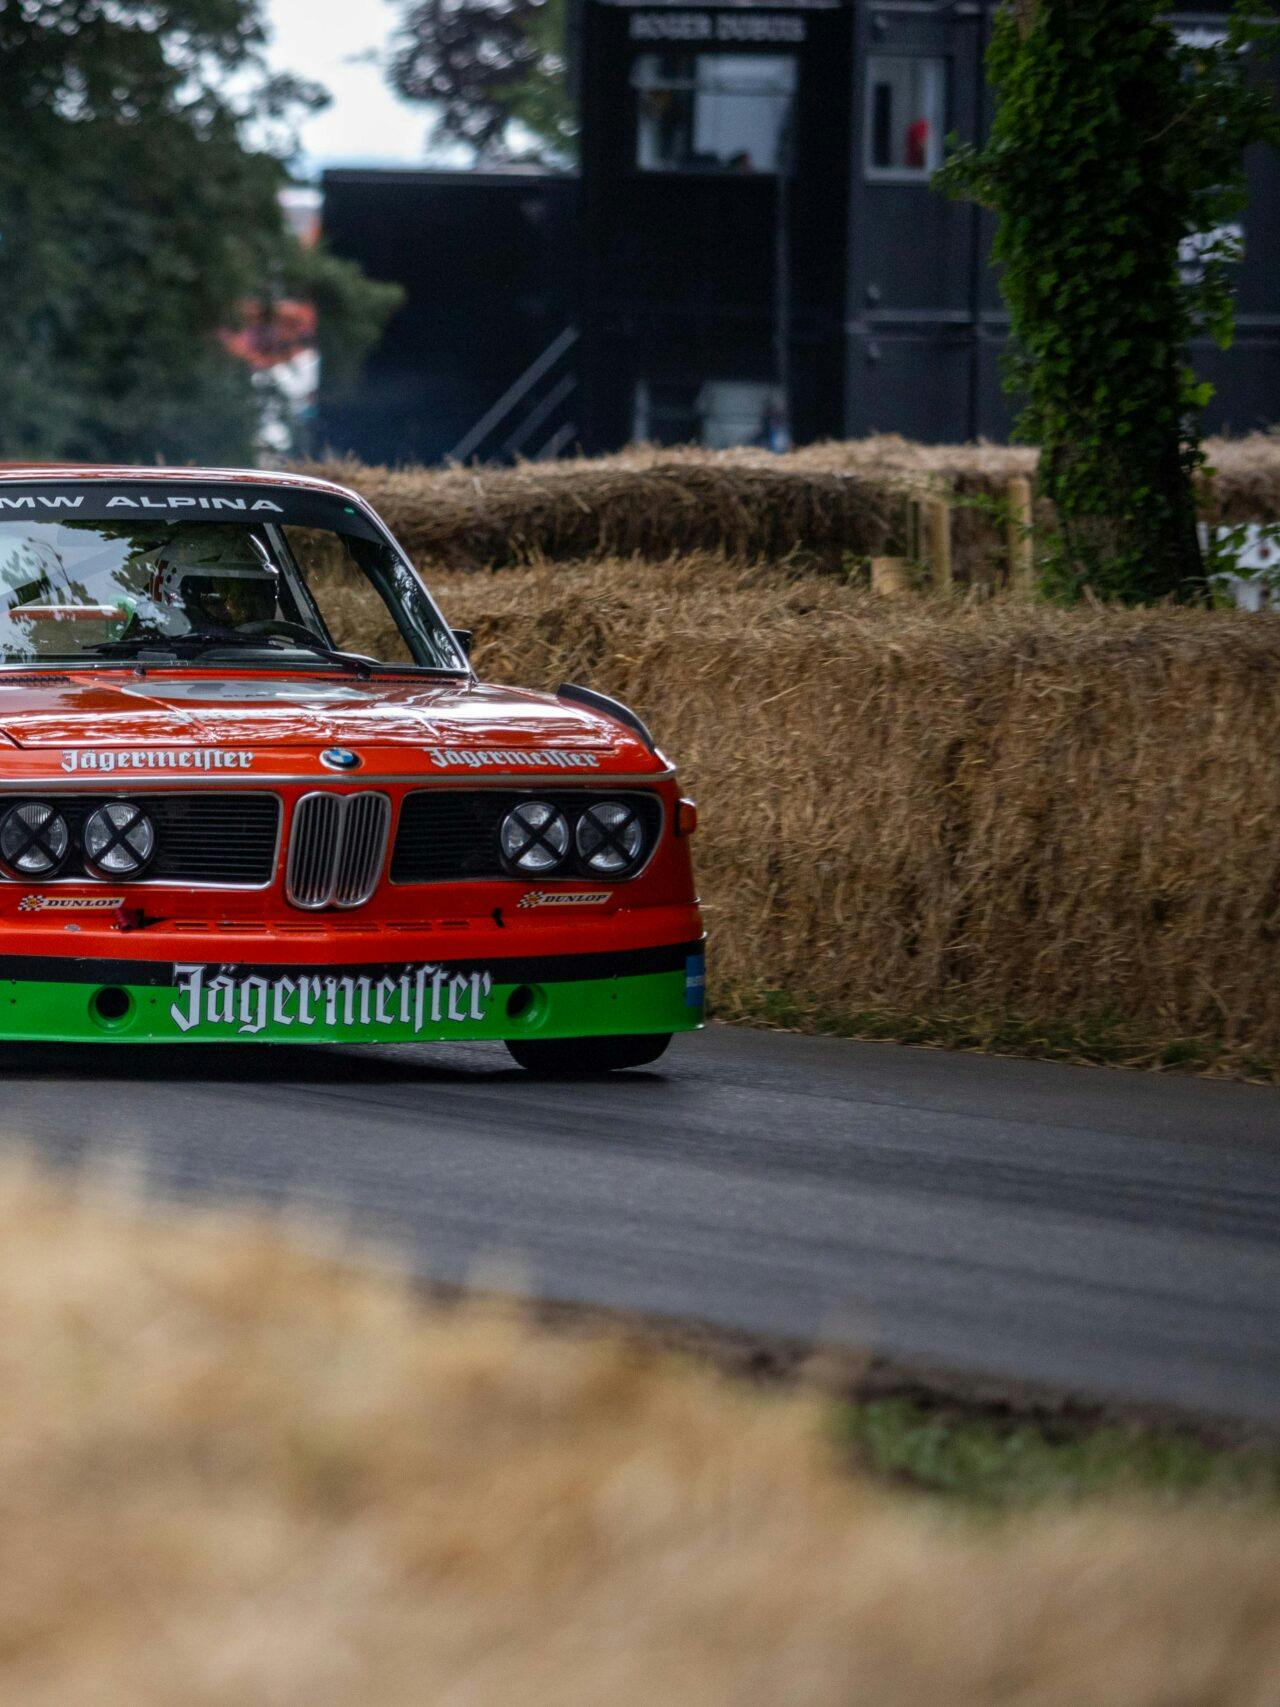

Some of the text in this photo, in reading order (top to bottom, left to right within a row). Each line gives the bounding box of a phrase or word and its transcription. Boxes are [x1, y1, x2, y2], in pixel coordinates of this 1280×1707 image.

[106, 496, 284, 512] ALPINA
[47, 899, 120, 907] DUNLOP
[544, 894, 607, 903] DUNLOP
